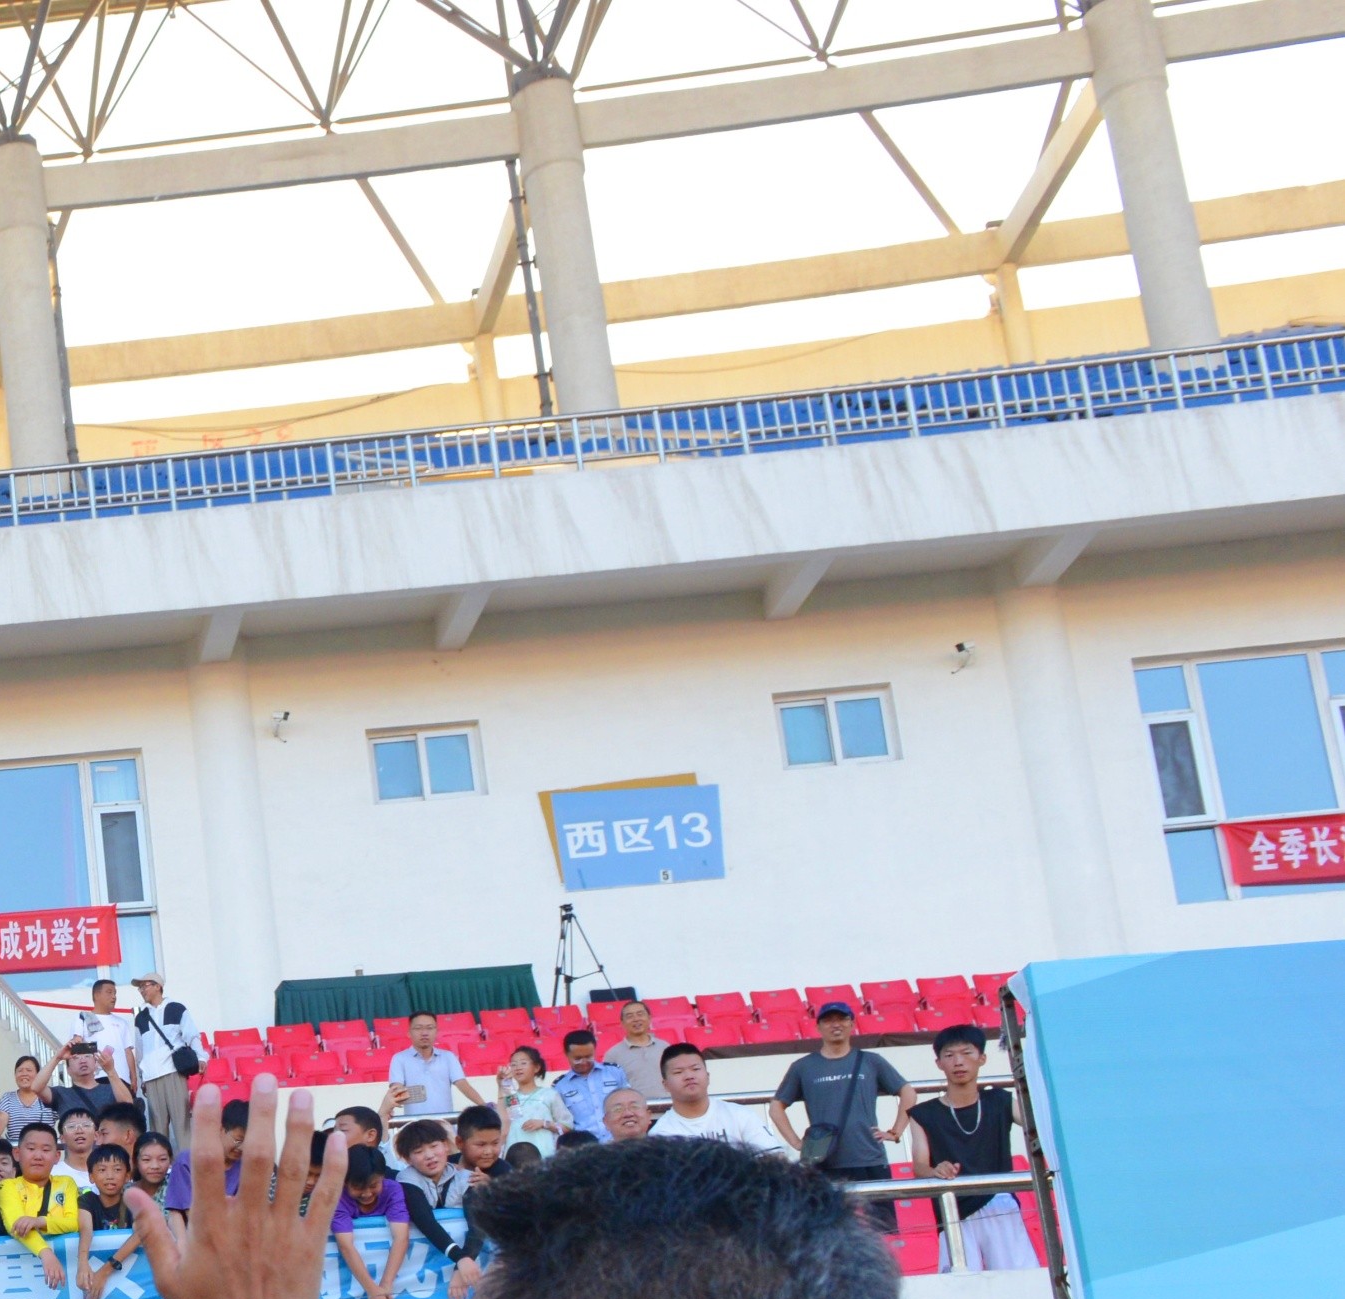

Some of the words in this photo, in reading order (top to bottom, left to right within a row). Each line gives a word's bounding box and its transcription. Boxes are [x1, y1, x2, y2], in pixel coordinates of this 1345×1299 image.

[562, 812, 713, 860] 西区13
[1249, 826, 1345, 871] 全季长
[662, 871, 670, 881] 5
